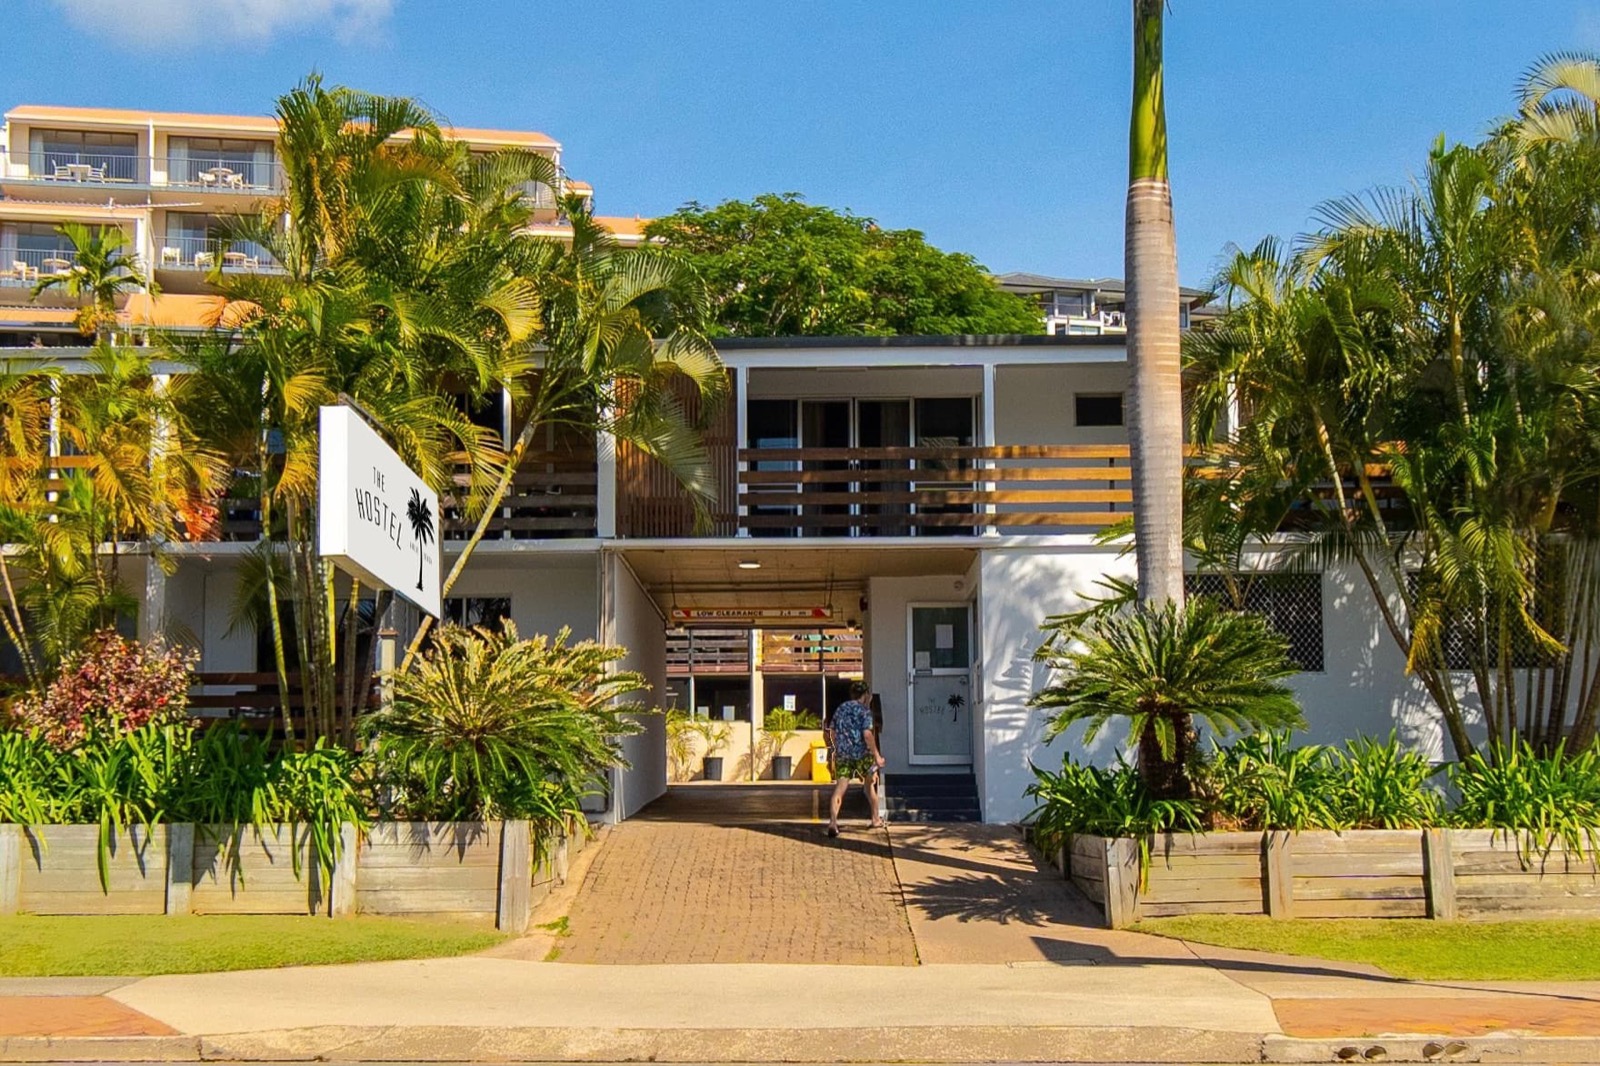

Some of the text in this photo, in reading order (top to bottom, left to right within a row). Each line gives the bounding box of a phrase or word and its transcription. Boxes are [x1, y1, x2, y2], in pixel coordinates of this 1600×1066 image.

[372, 466, 386, 493] THE
[355, 487, 402, 551] HOSTEL
[697, 609, 714, 617] LOW
[716, 609, 763, 617] CLEARANCE
